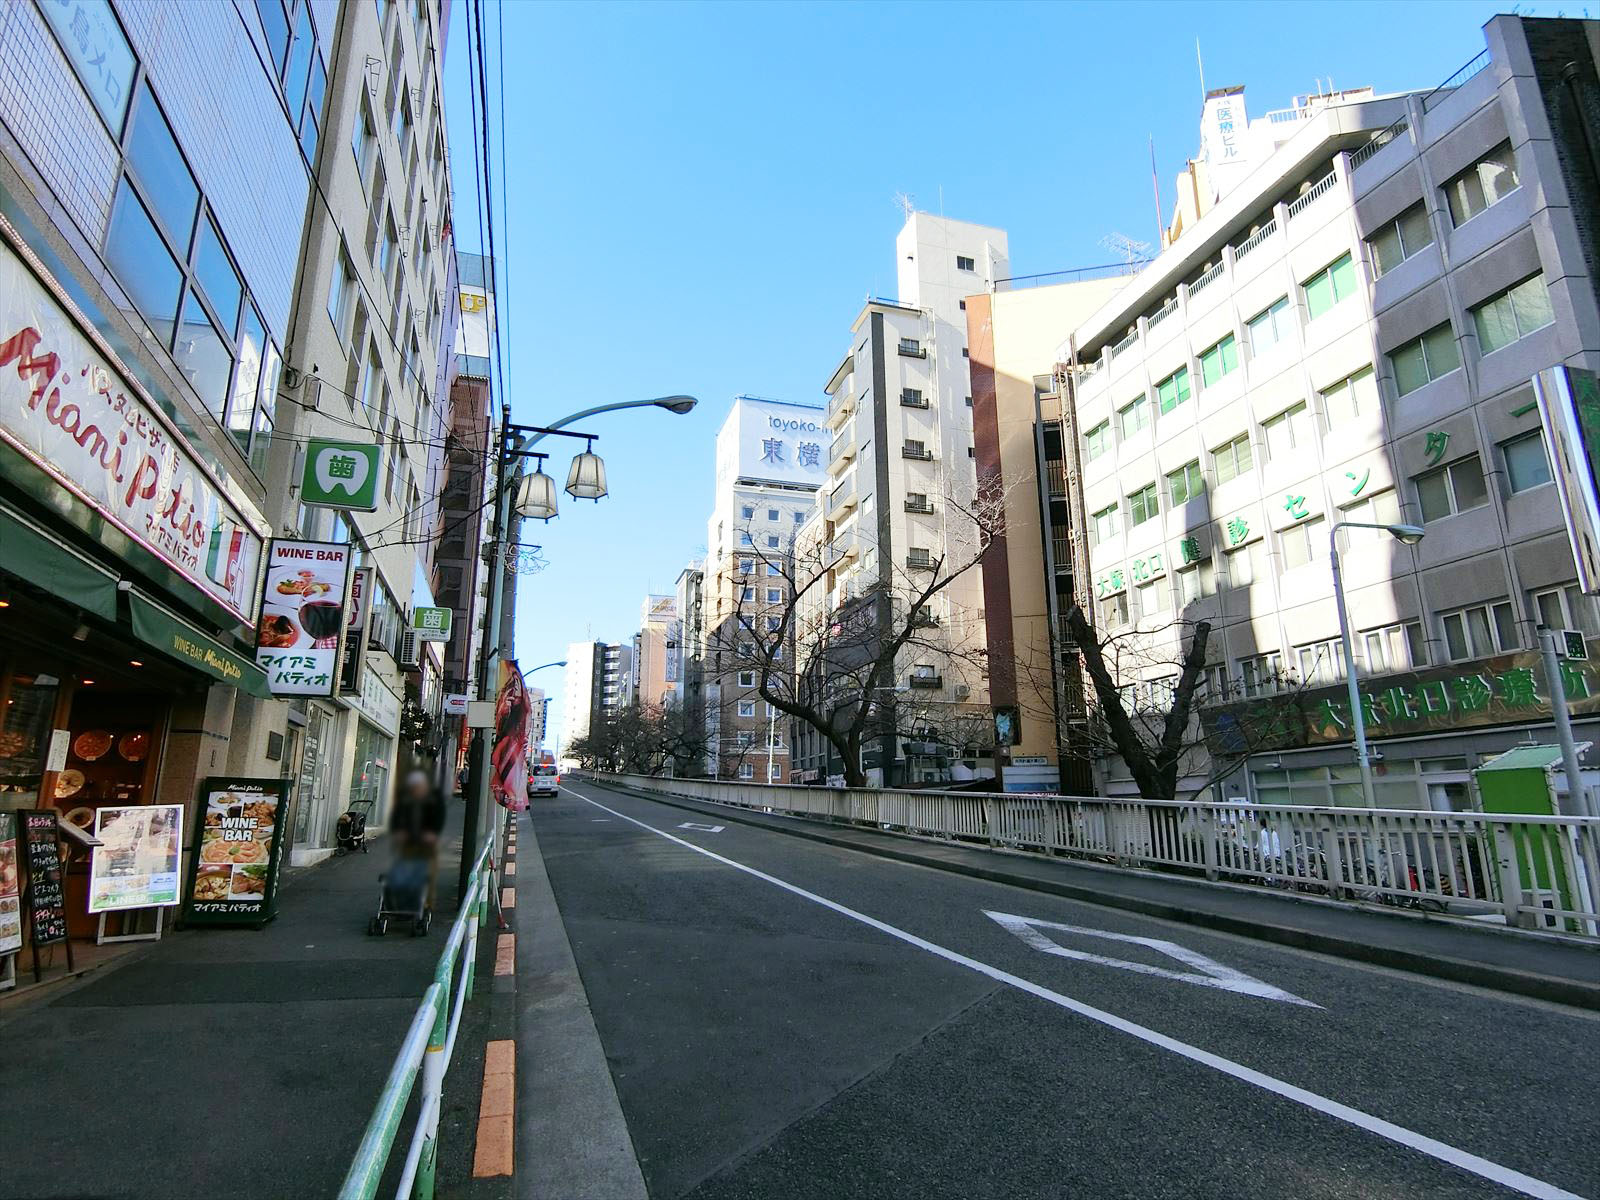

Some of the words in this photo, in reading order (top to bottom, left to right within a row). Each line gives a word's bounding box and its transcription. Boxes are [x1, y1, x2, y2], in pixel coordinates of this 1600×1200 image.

[329, 455, 356, 479] 歯
[277, 547, 313, 560] WINE
[316, 550, 344, 562] BAR
[423, 610, 443, 628] 歯
[260, 655, 317, 670] マイアミ
[275, 671, 330, 687] パティオ
[221, 817, 259, 829] WINE
[224, 829, 253, 842] BAR
